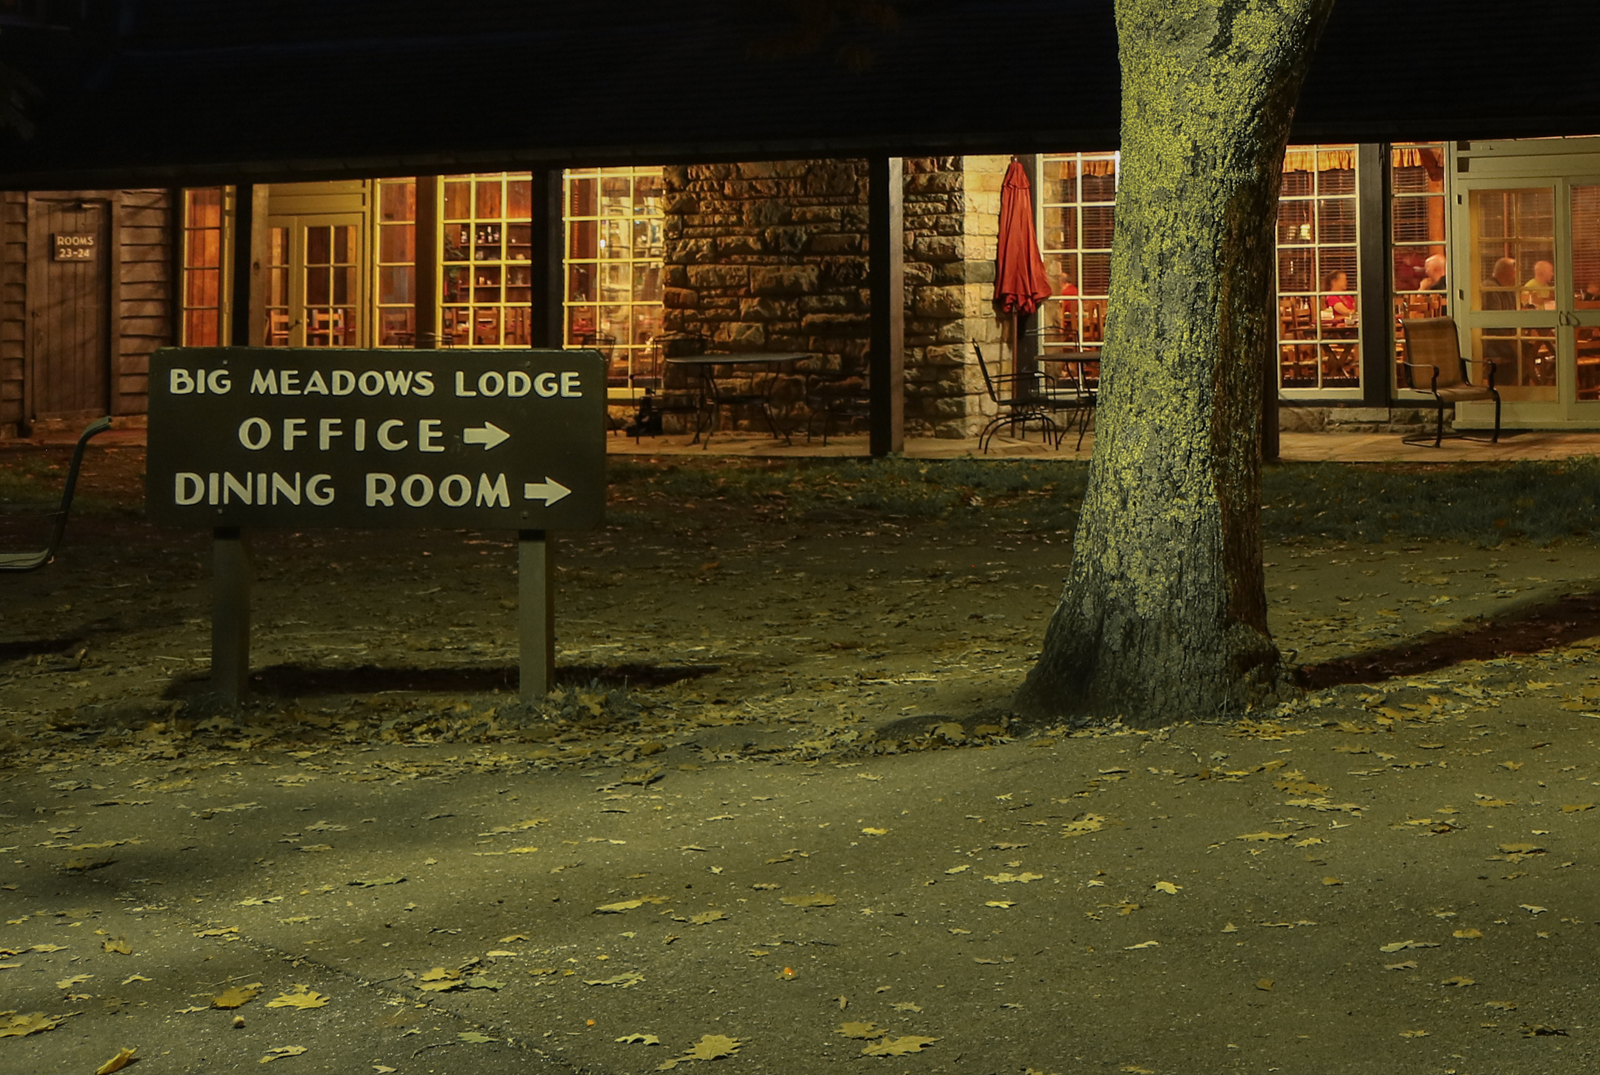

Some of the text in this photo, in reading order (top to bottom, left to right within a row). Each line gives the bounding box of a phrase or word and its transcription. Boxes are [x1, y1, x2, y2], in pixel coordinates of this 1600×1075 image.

[57, 236, 94, 246] ROOMS
[59, 248, 90, 258] 23-24
[169, 368, 583, 398] BIG MEADOWS LODGE
[238, 417, 446, 453] OFFICE
[174, 471, 511, 508] DINING ROOM
